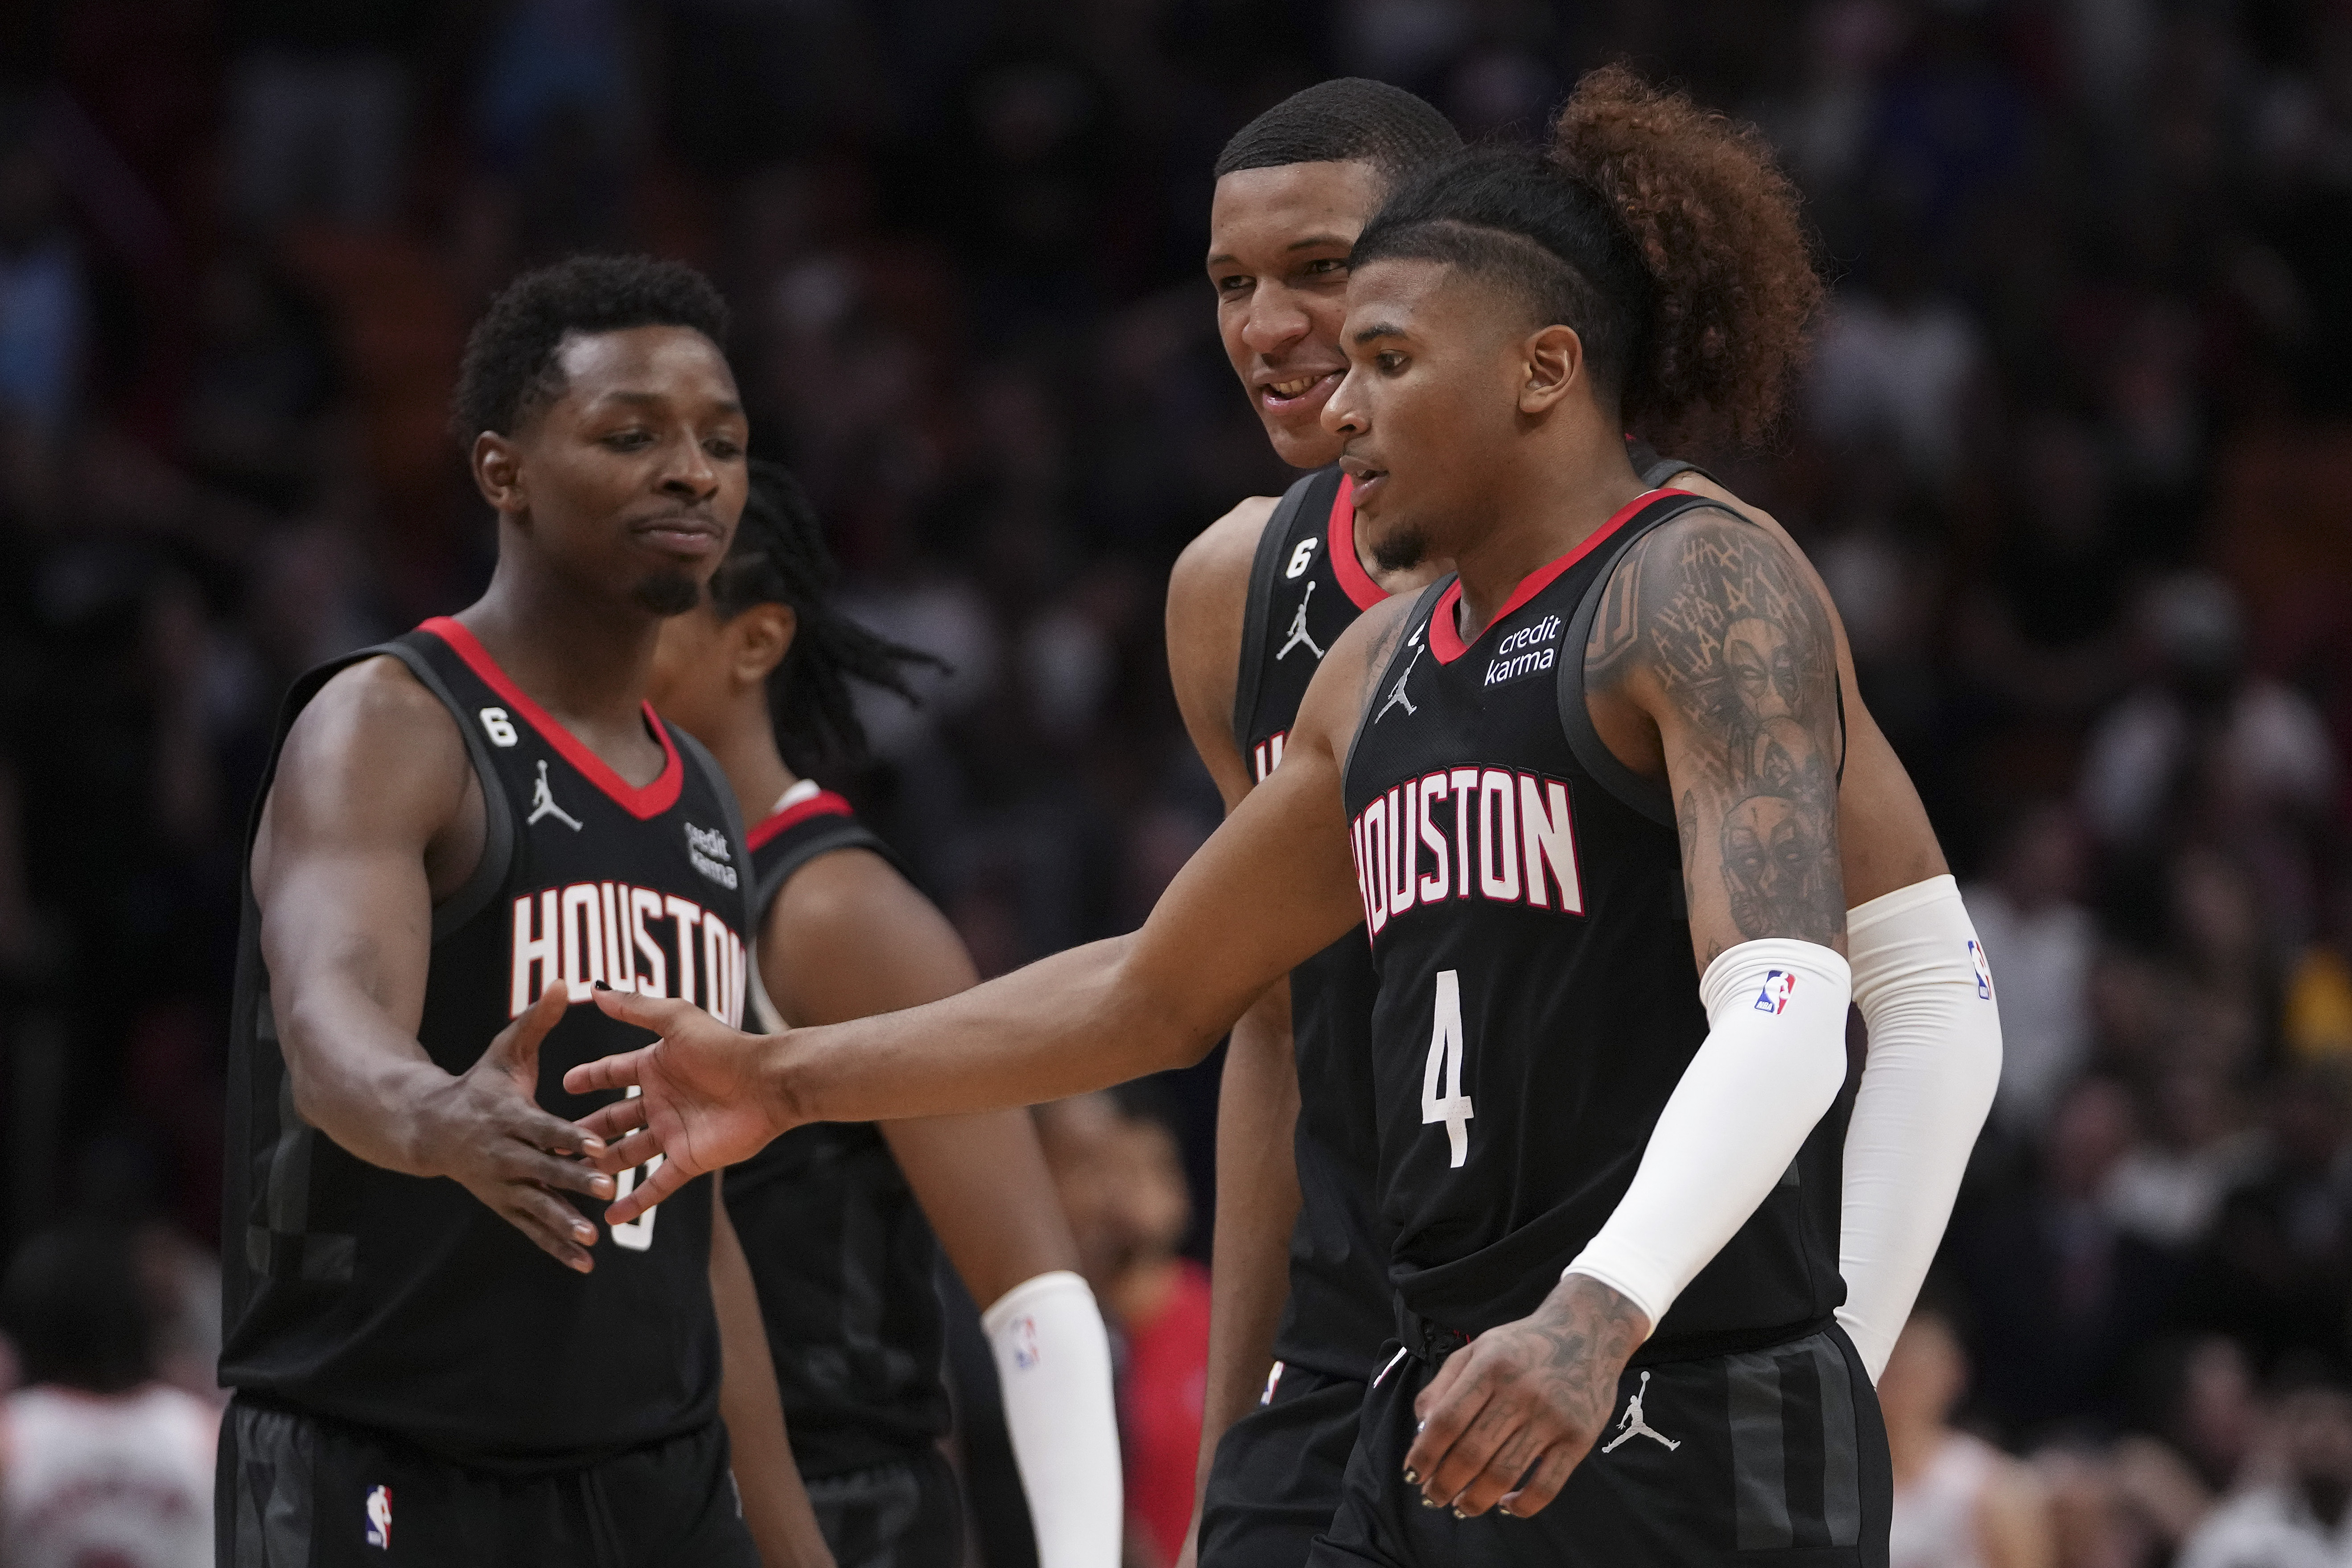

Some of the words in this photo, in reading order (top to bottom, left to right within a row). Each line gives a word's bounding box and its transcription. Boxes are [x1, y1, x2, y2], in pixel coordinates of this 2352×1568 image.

[1285, 537, 1318, 579] 6
[1499, 615, 1561, 655] credit
[1484, 648, 1554, 686] karma
[479, 707, 518, 747] 6
[1757, 1001, 1773, 1011] NBA
[1422, 969, 1474, 1168] 4
